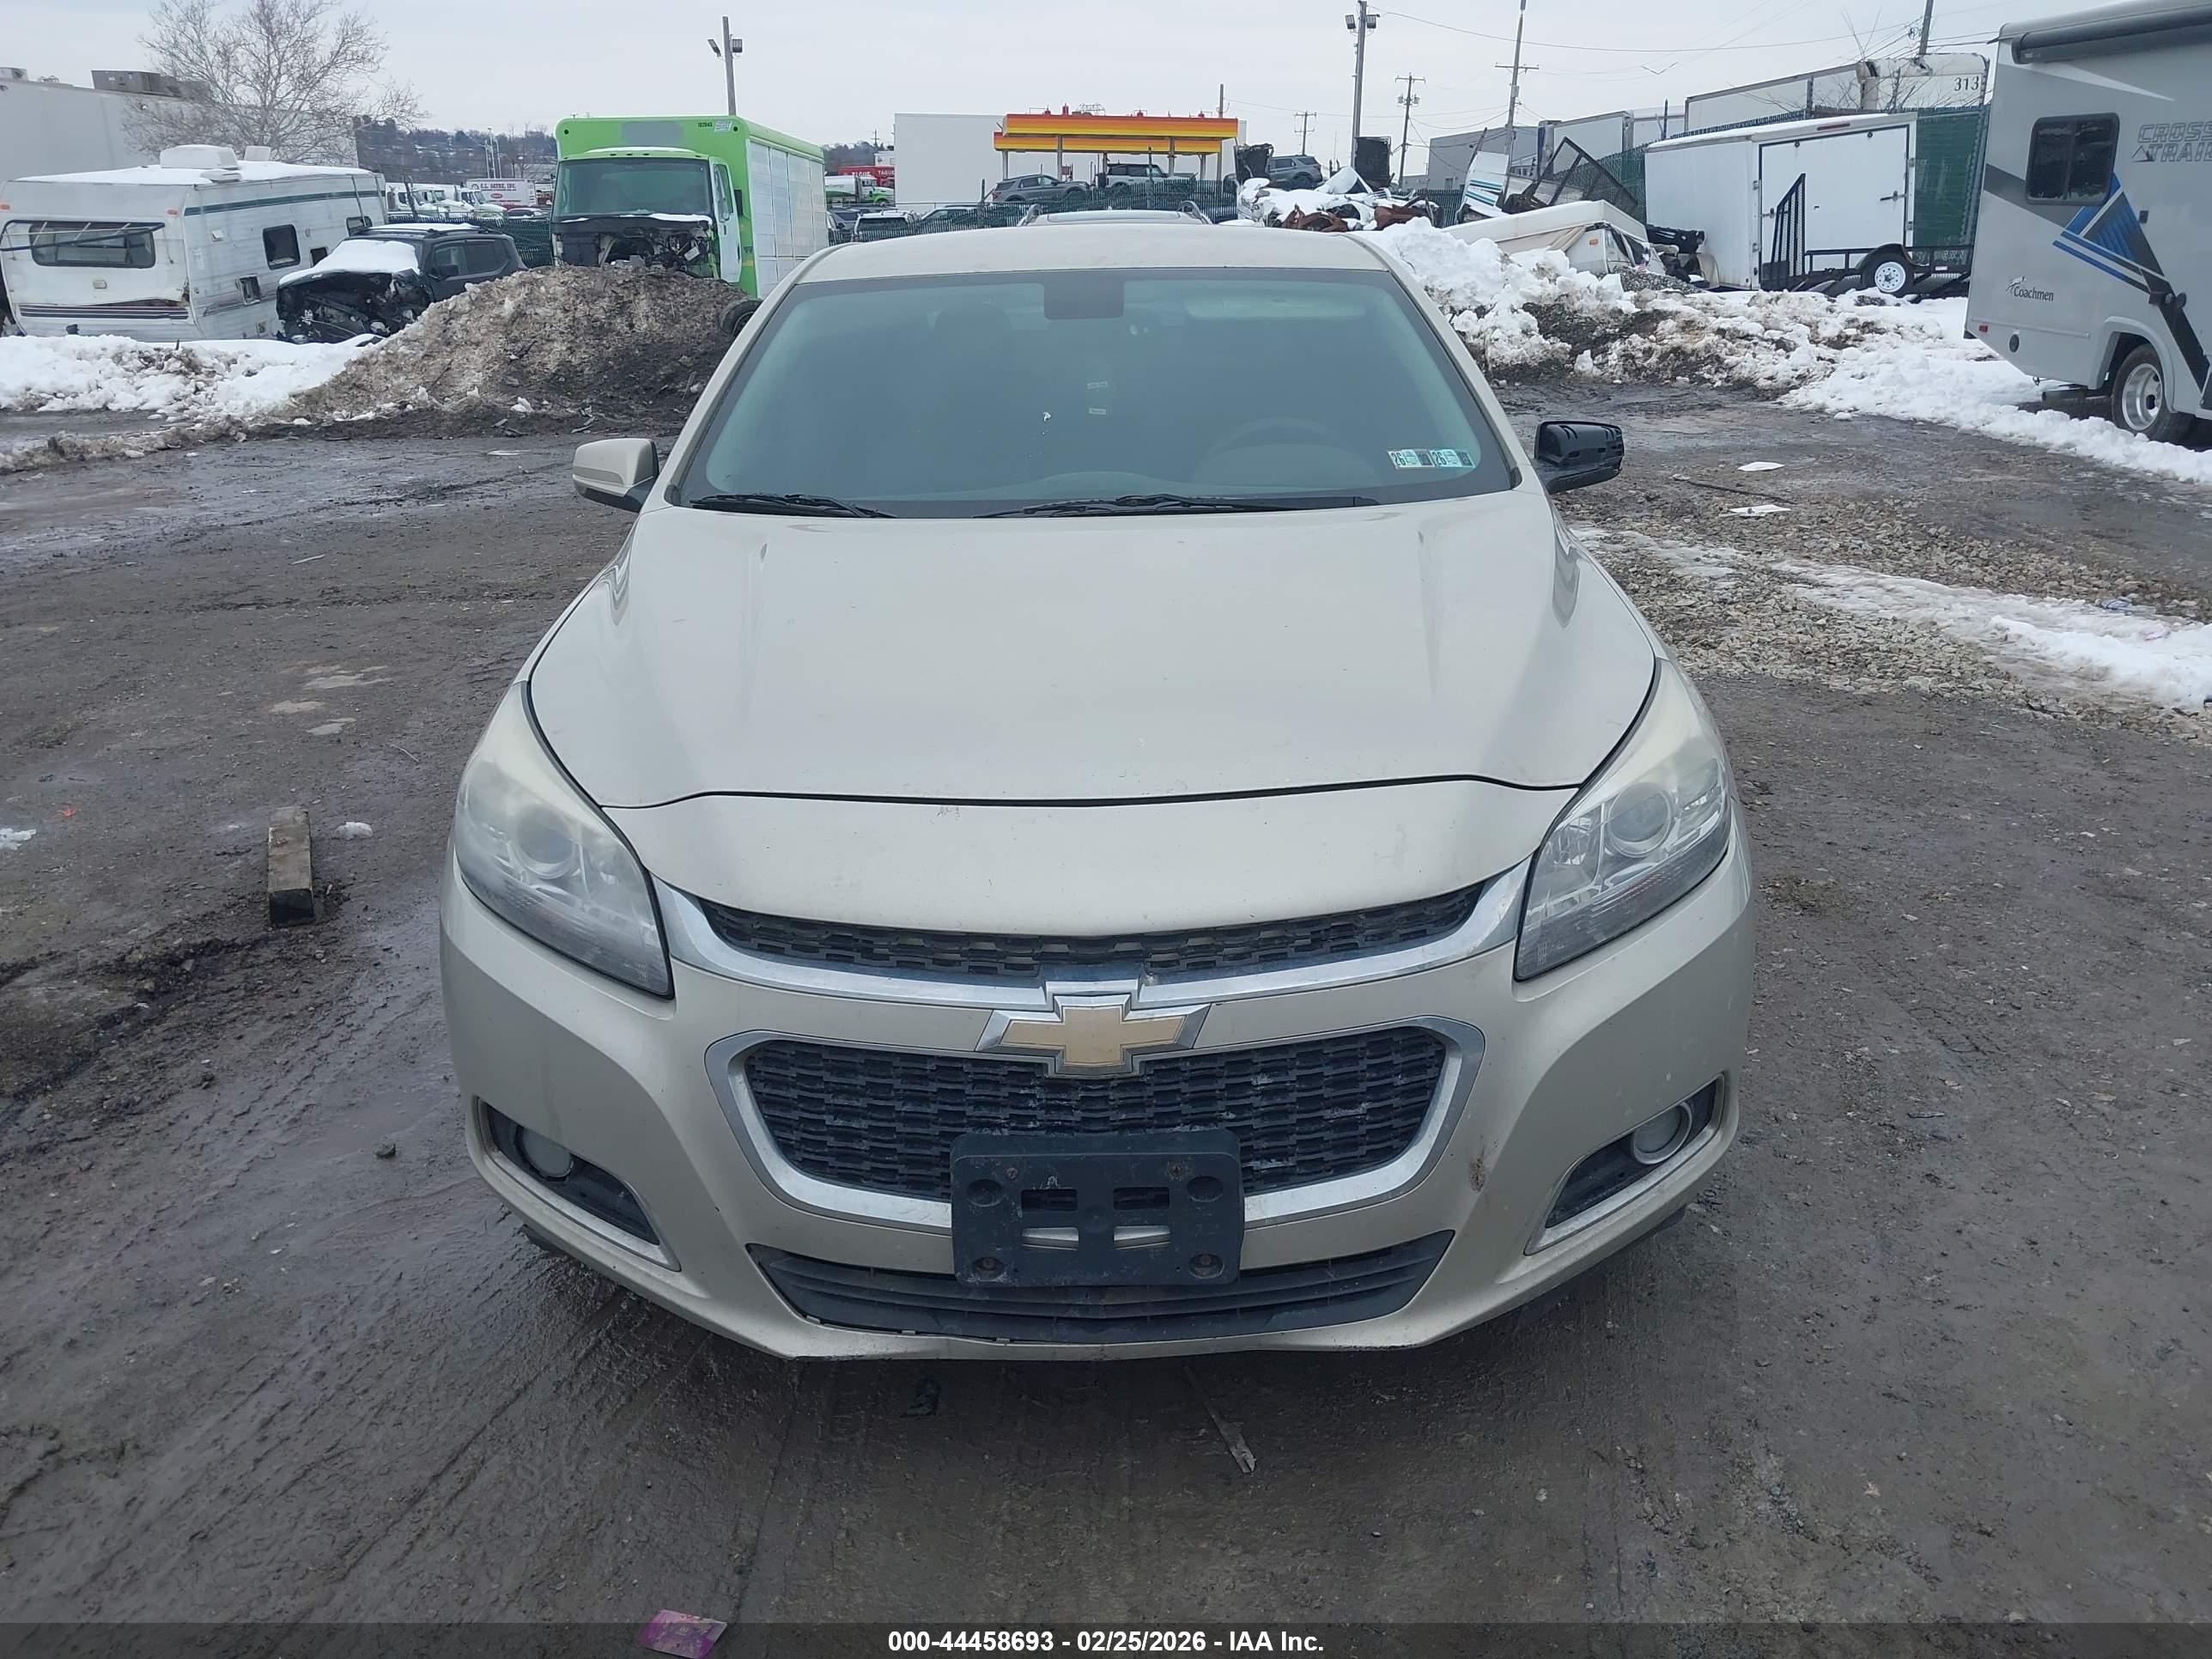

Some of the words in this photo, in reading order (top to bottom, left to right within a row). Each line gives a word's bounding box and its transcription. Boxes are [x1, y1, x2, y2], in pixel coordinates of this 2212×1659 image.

[1954, 76, 1979, 91] 313
[2014, 286, 2054, 301] Coachmen
[1391, 453, 1407, 466] 26
[1431, 452, 1447, 465] 26
